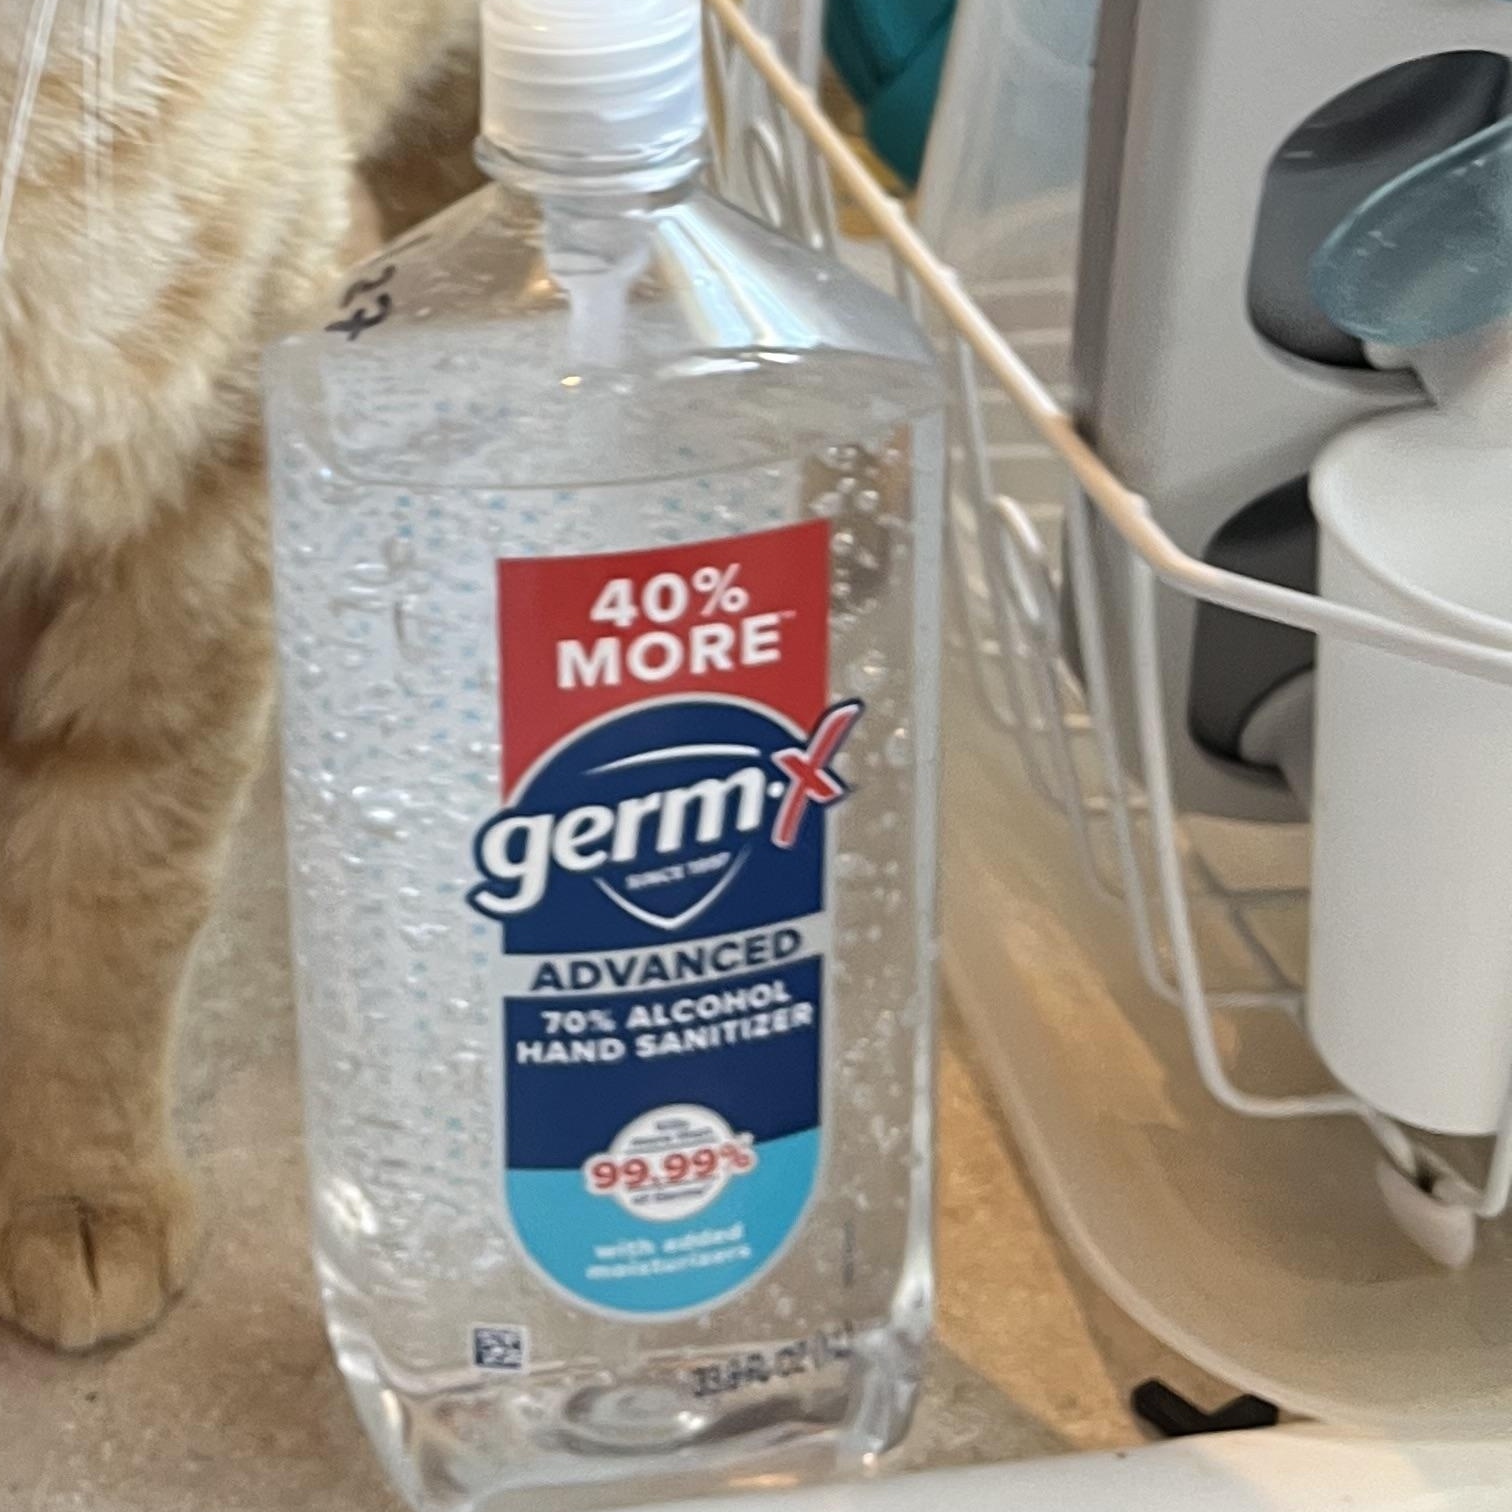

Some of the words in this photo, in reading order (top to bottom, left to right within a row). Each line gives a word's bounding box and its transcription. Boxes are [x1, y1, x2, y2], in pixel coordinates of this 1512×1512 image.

[590, 563, 749, 628] 40%
[557, 614, 781, 689] MORE
[530, 928, 802, 991] ADVANCED
[515, 1037, 626, 1065] HAND
[635, 1001, 814, 1058] SANITIZER
[541, 1008, 616, 1035] 70%
[626, 980, 791, 1029] ALCOHOL
[592, 1144, 752, 1190] 99.99%
